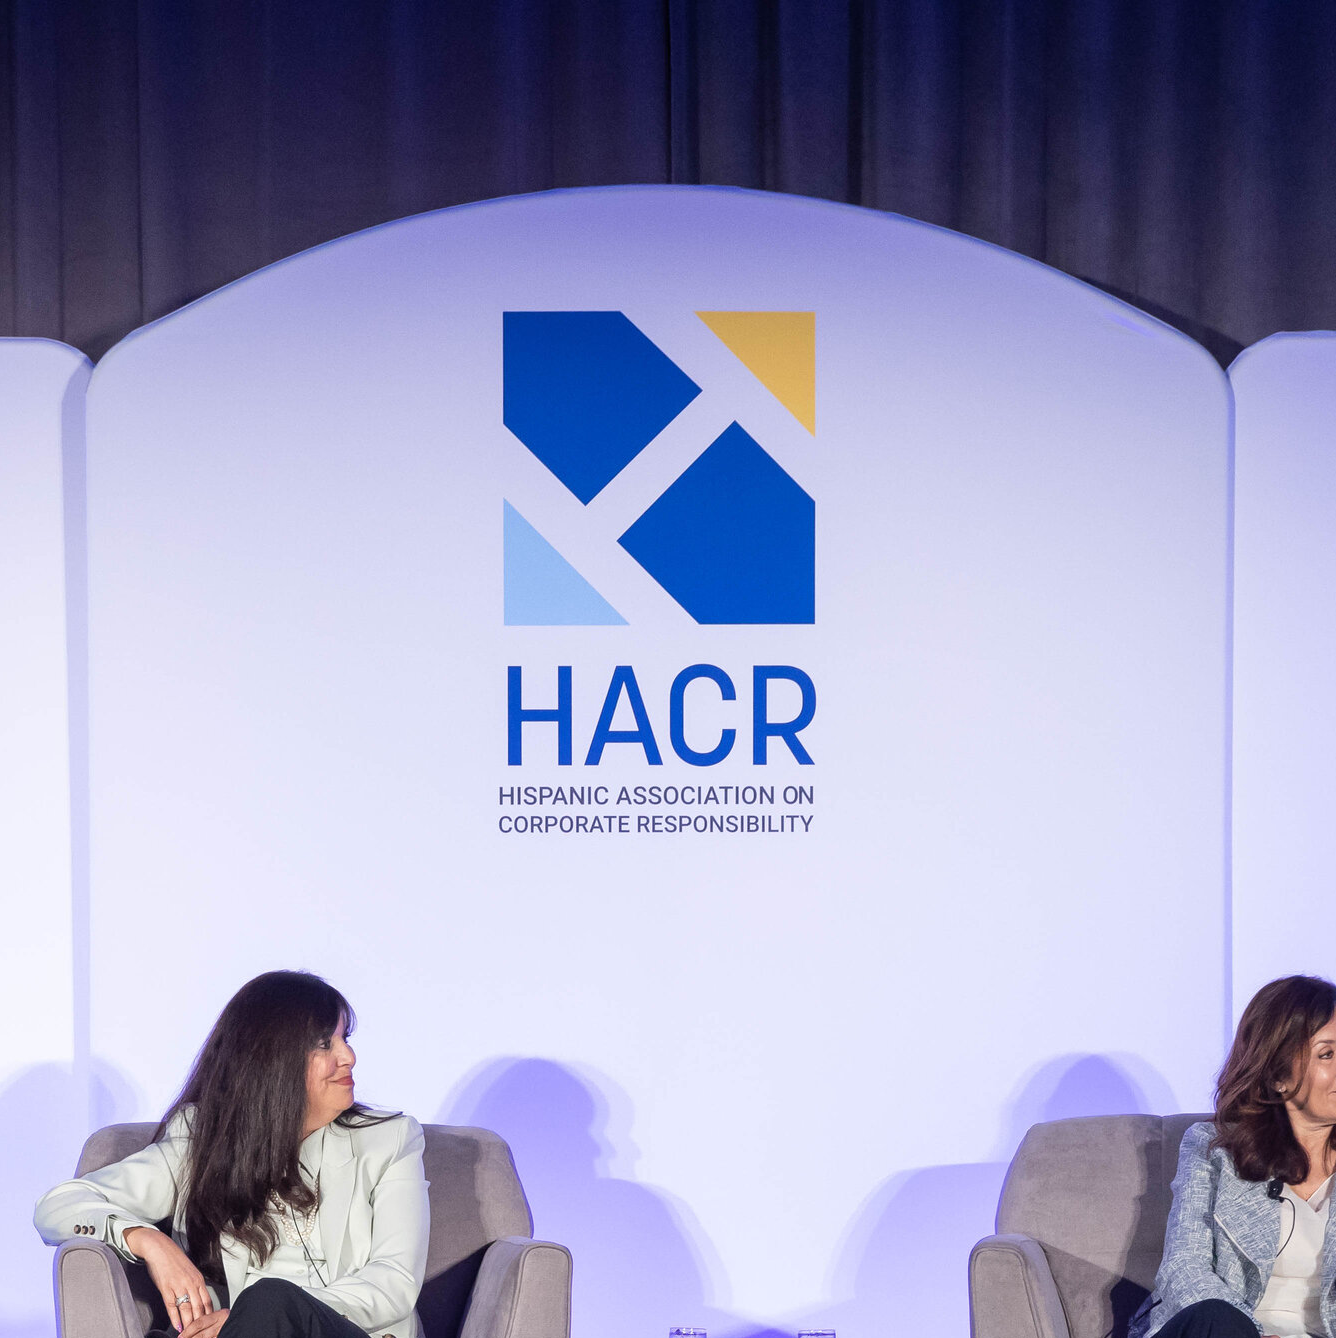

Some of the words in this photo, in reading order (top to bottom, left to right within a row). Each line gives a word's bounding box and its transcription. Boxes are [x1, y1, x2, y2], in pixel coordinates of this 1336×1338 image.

[507, 663, 817, 767] HACR
[499, 786, 609, 805] HISPANIC
[616, 785, 775, 805] ASSOCIATION
[783, 785, 814, 805] ON
[498, 815, 630, 833] CORPORATE
[637, 815, 814, 833] RESPONSIBILITY
